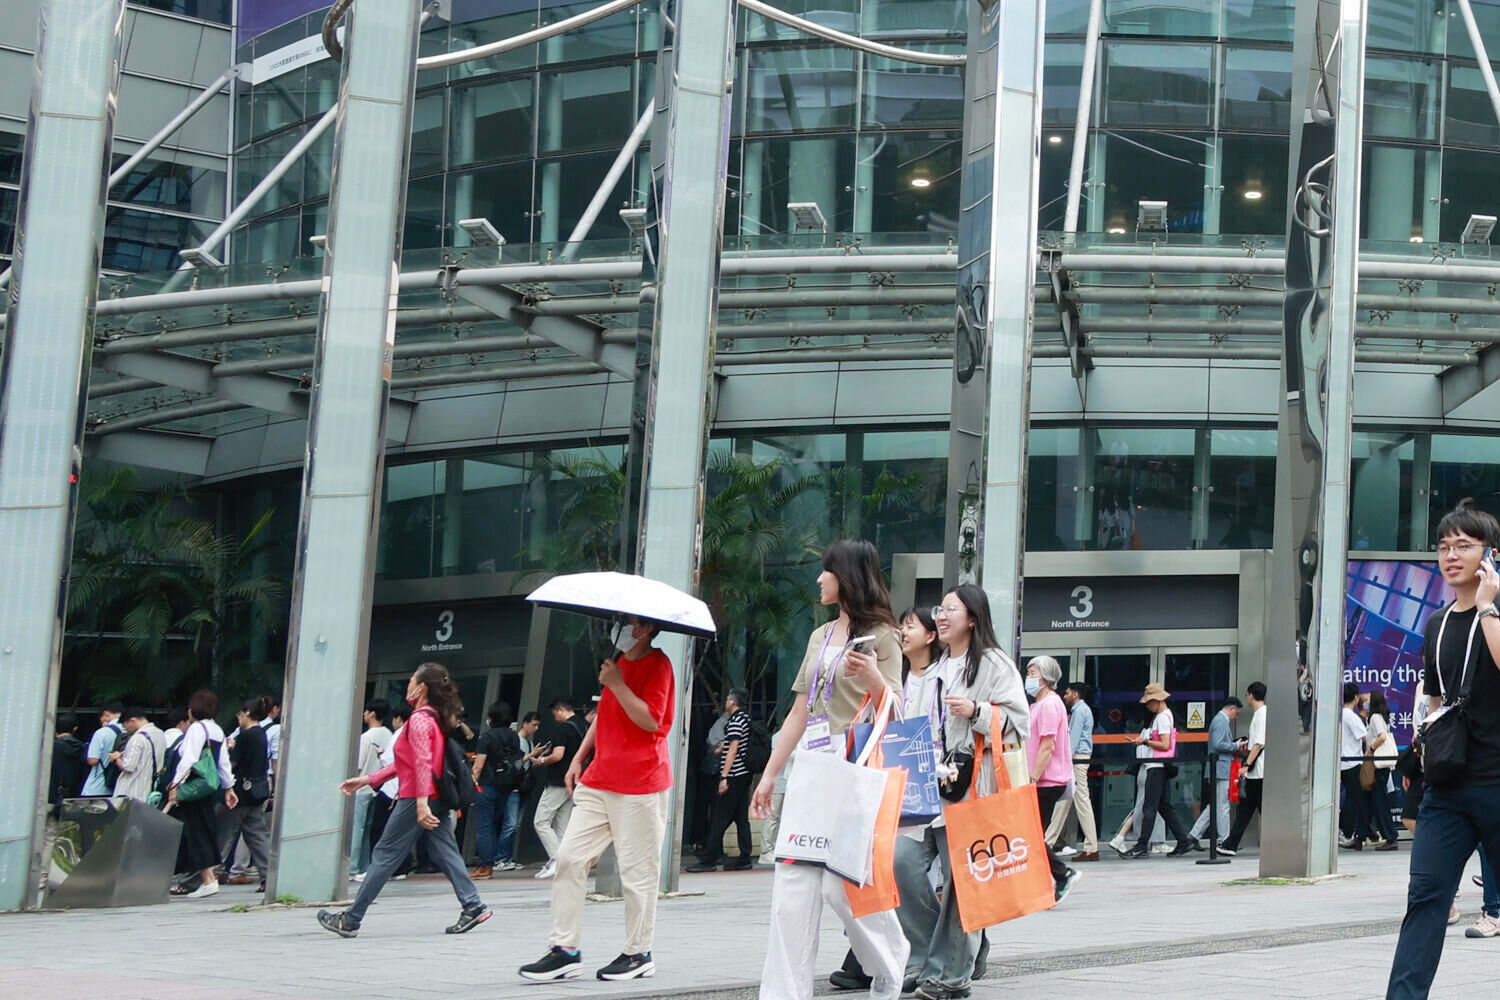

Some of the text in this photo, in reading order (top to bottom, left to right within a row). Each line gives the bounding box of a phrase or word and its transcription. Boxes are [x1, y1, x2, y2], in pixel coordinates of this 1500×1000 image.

[1069, 585, 1094, 619] 3
[436, 610, 455, 642] 3
[1051, 620, 1110, 628] North Entrance
[1343, 664, 1425, 687] ating the
[788, 834, 831, 850] KEYEN
